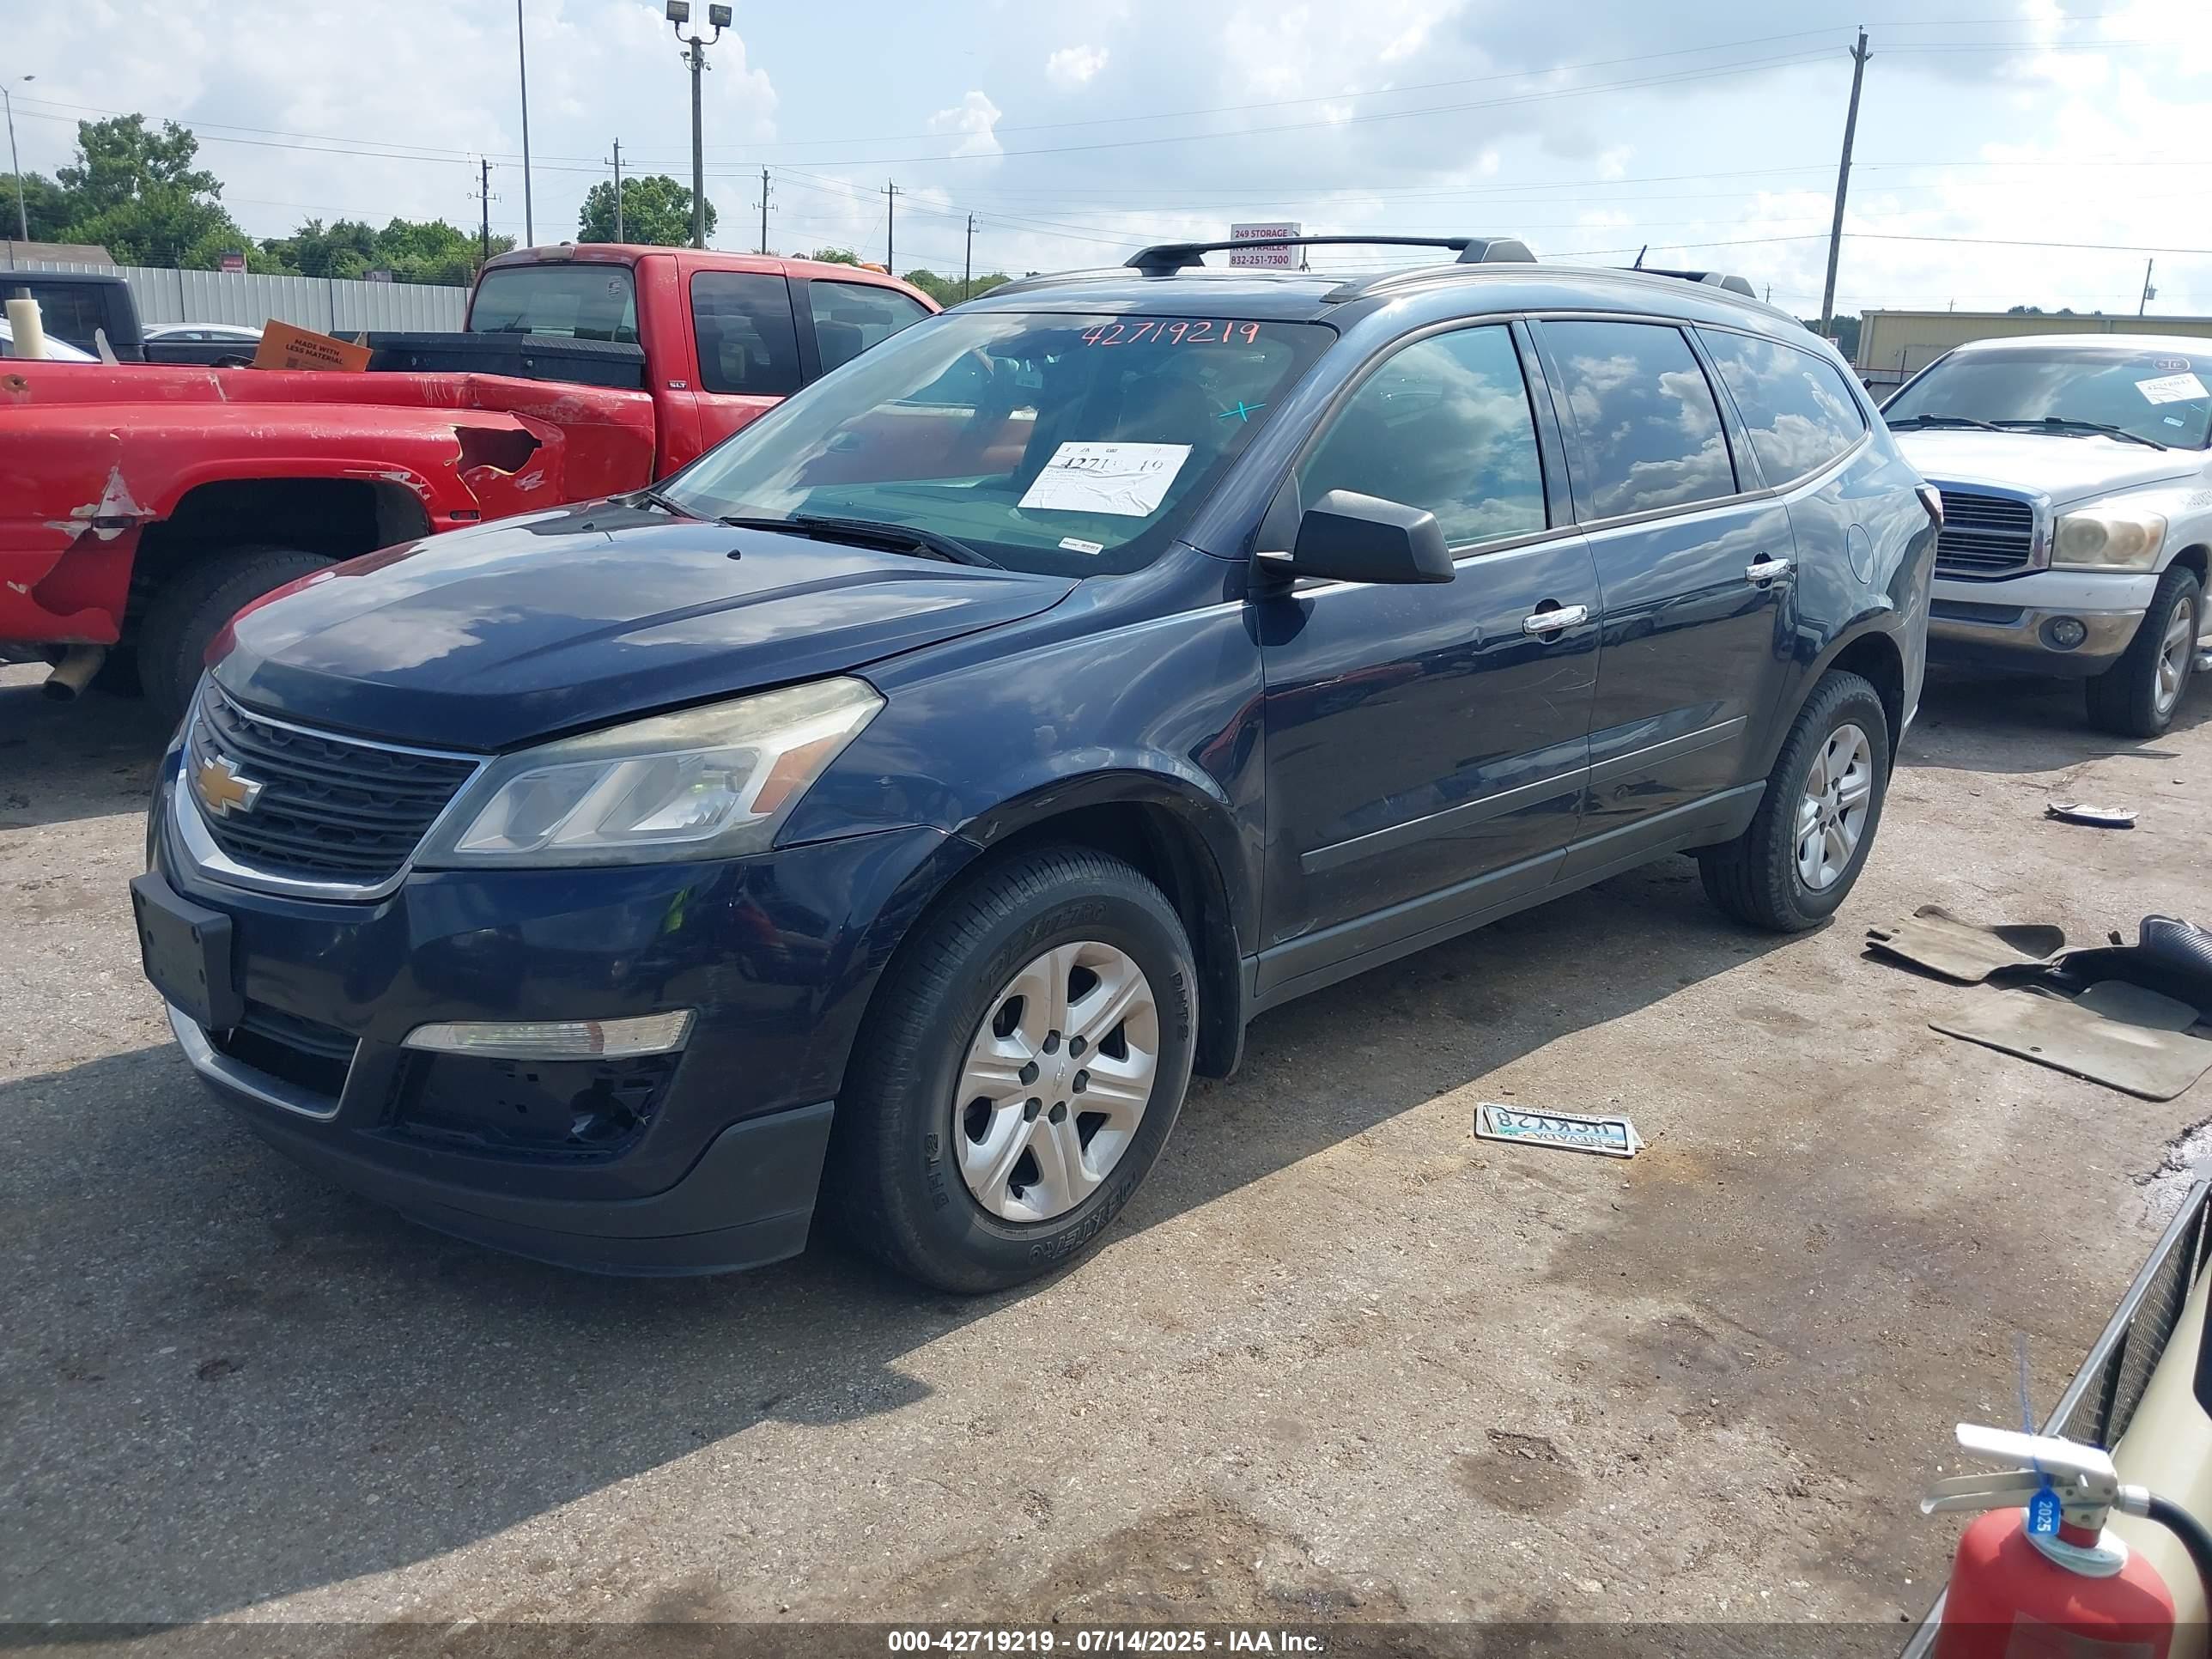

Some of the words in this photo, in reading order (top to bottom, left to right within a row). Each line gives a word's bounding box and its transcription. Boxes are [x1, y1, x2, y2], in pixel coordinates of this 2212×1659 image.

[1231, 255, 1289, 265] 832-251-7300
[1081, 321, 1261, 347] 42719219
[285, 343, 304, 354] LESS
[305, 349, 343, 365] MATERIAL
[295, 338, 317, 349] MADE
[319, 345, 340, 356] WITH
[1531, 1132, 1602, 1145] NEVADA
[2037, 1501, 2053, 1532] 2025
